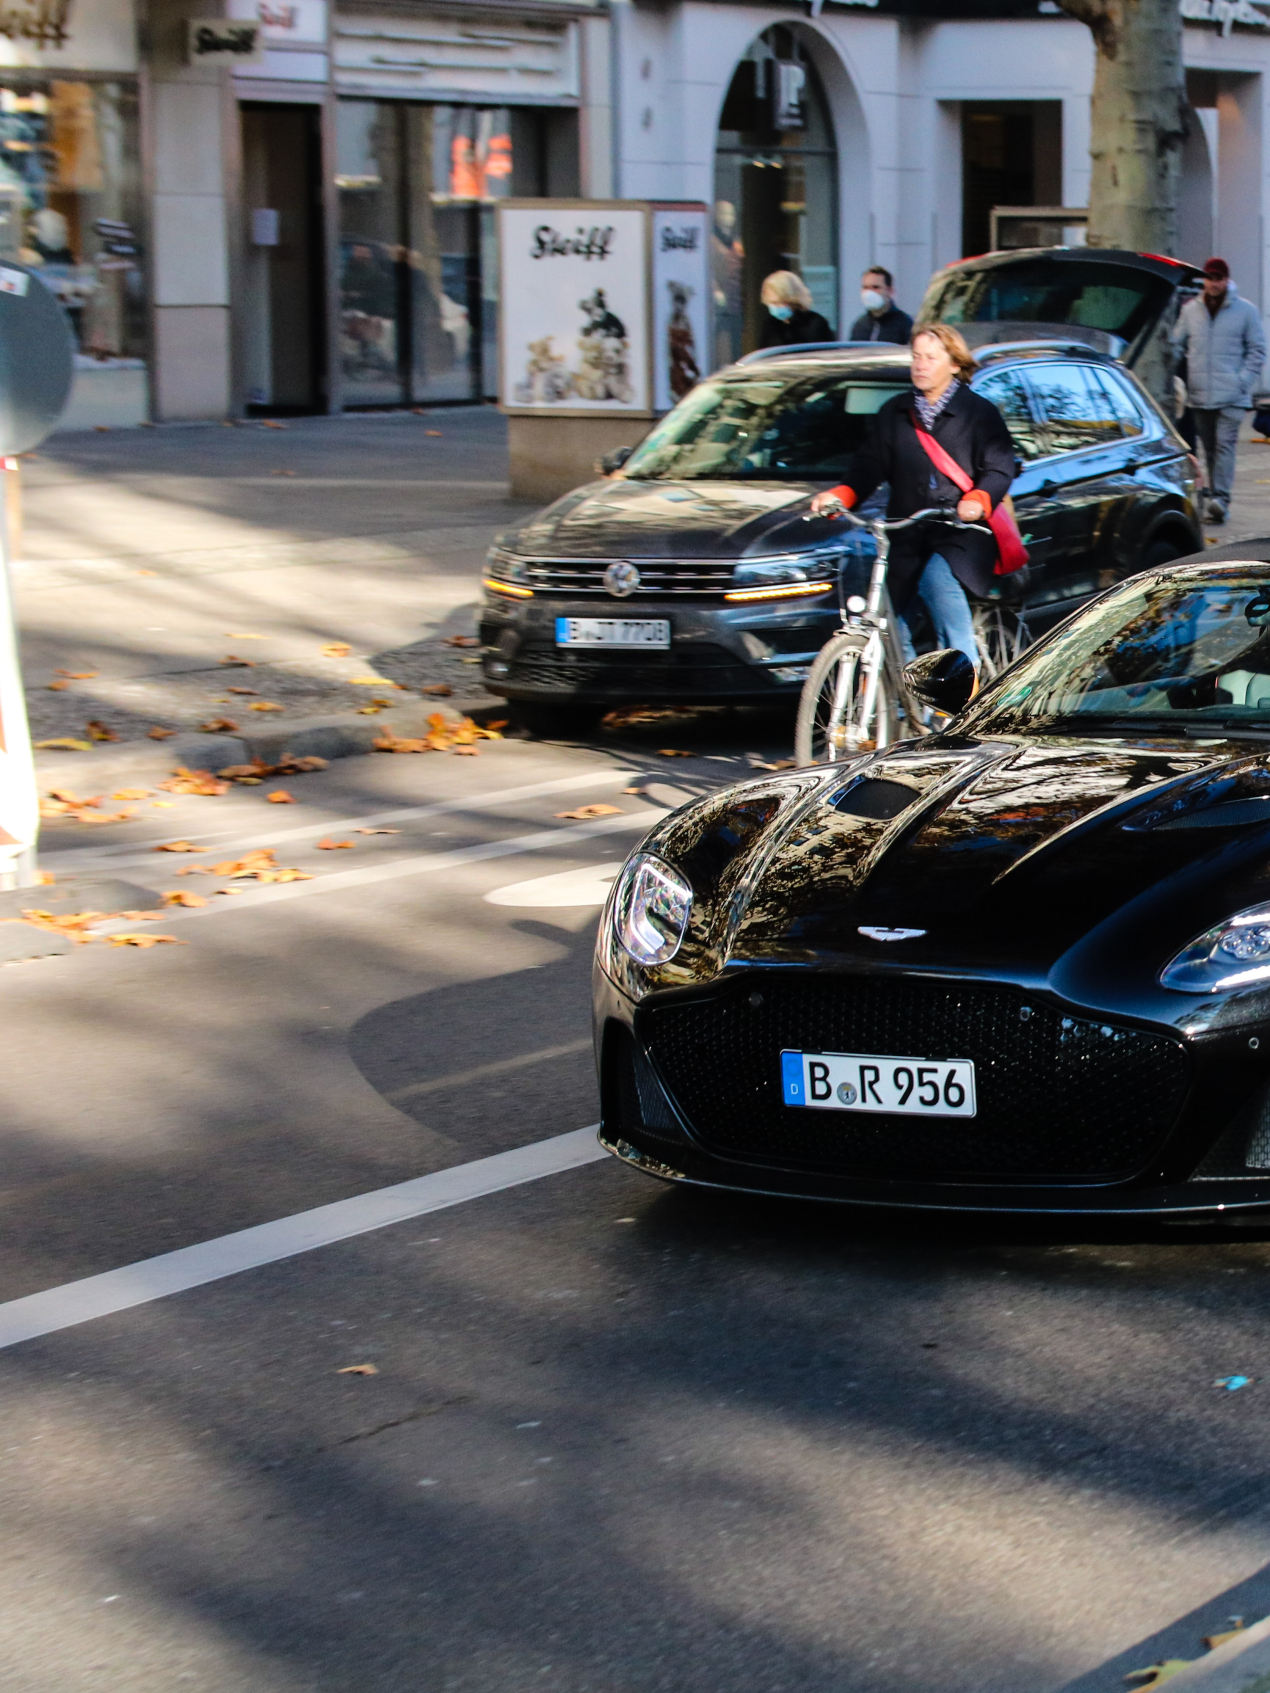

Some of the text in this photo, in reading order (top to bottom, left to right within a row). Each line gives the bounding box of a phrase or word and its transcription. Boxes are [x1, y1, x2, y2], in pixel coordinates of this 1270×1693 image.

[530, 225, 616, 261] Steiff
[809, 1061, 965, 1107] B R 956
